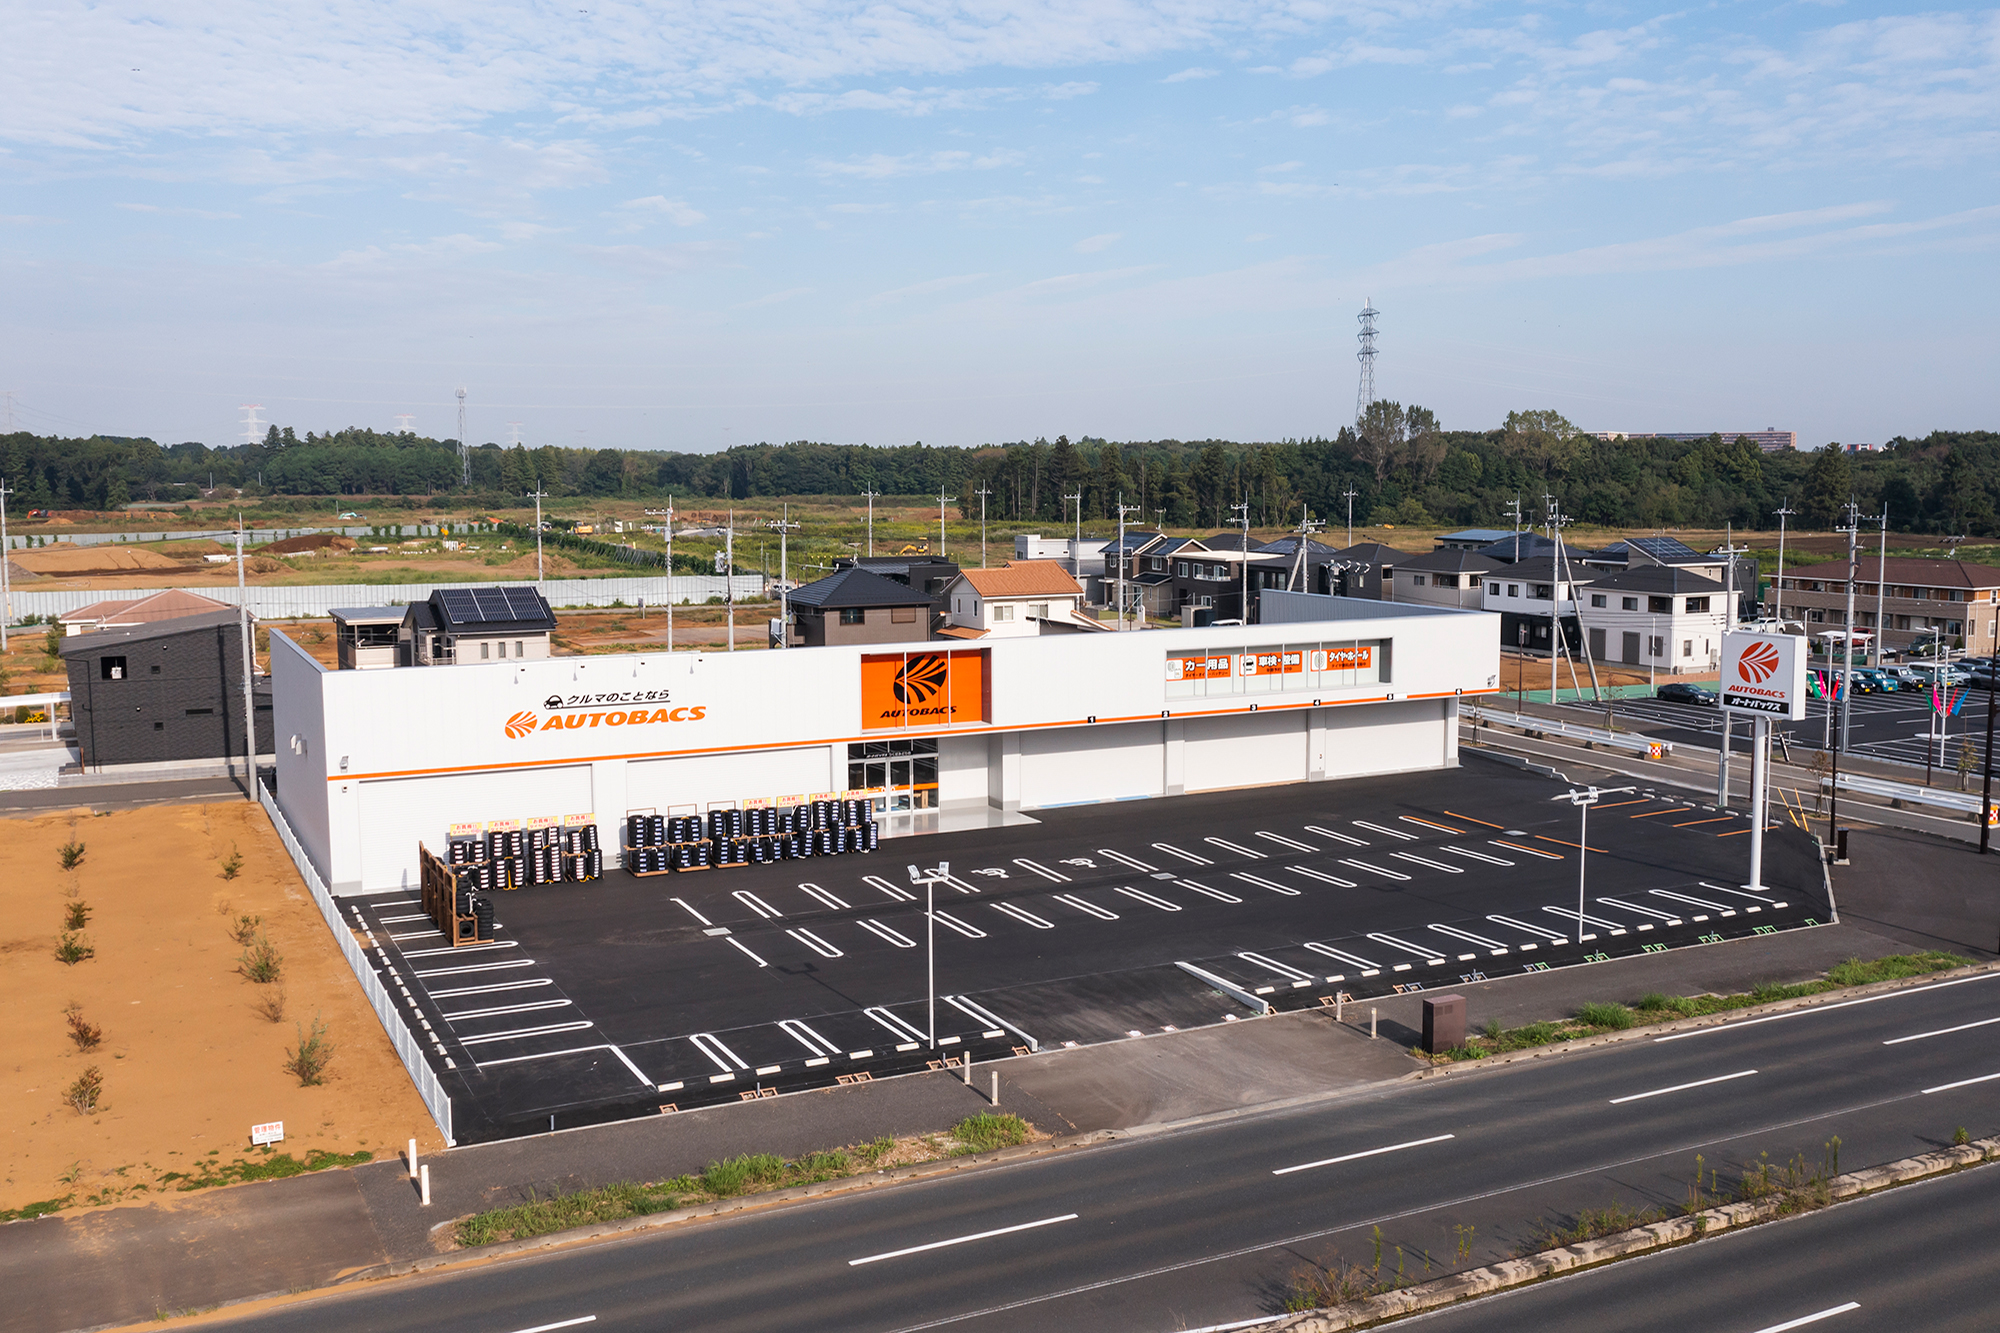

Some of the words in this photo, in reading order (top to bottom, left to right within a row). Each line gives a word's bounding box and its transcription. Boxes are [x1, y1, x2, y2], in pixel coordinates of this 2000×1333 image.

[1185, 657, 1229, 671] カー用品
[566, 689, 670, 705] クルマのことなら
[1728, 684, 1786, 699] AUTOBACS
[1730, 697, 1781, 711] オートバックス
[540, 706, 707, 731] AUTOBACS
[880, 705, 957, 719] AUTOBACS
